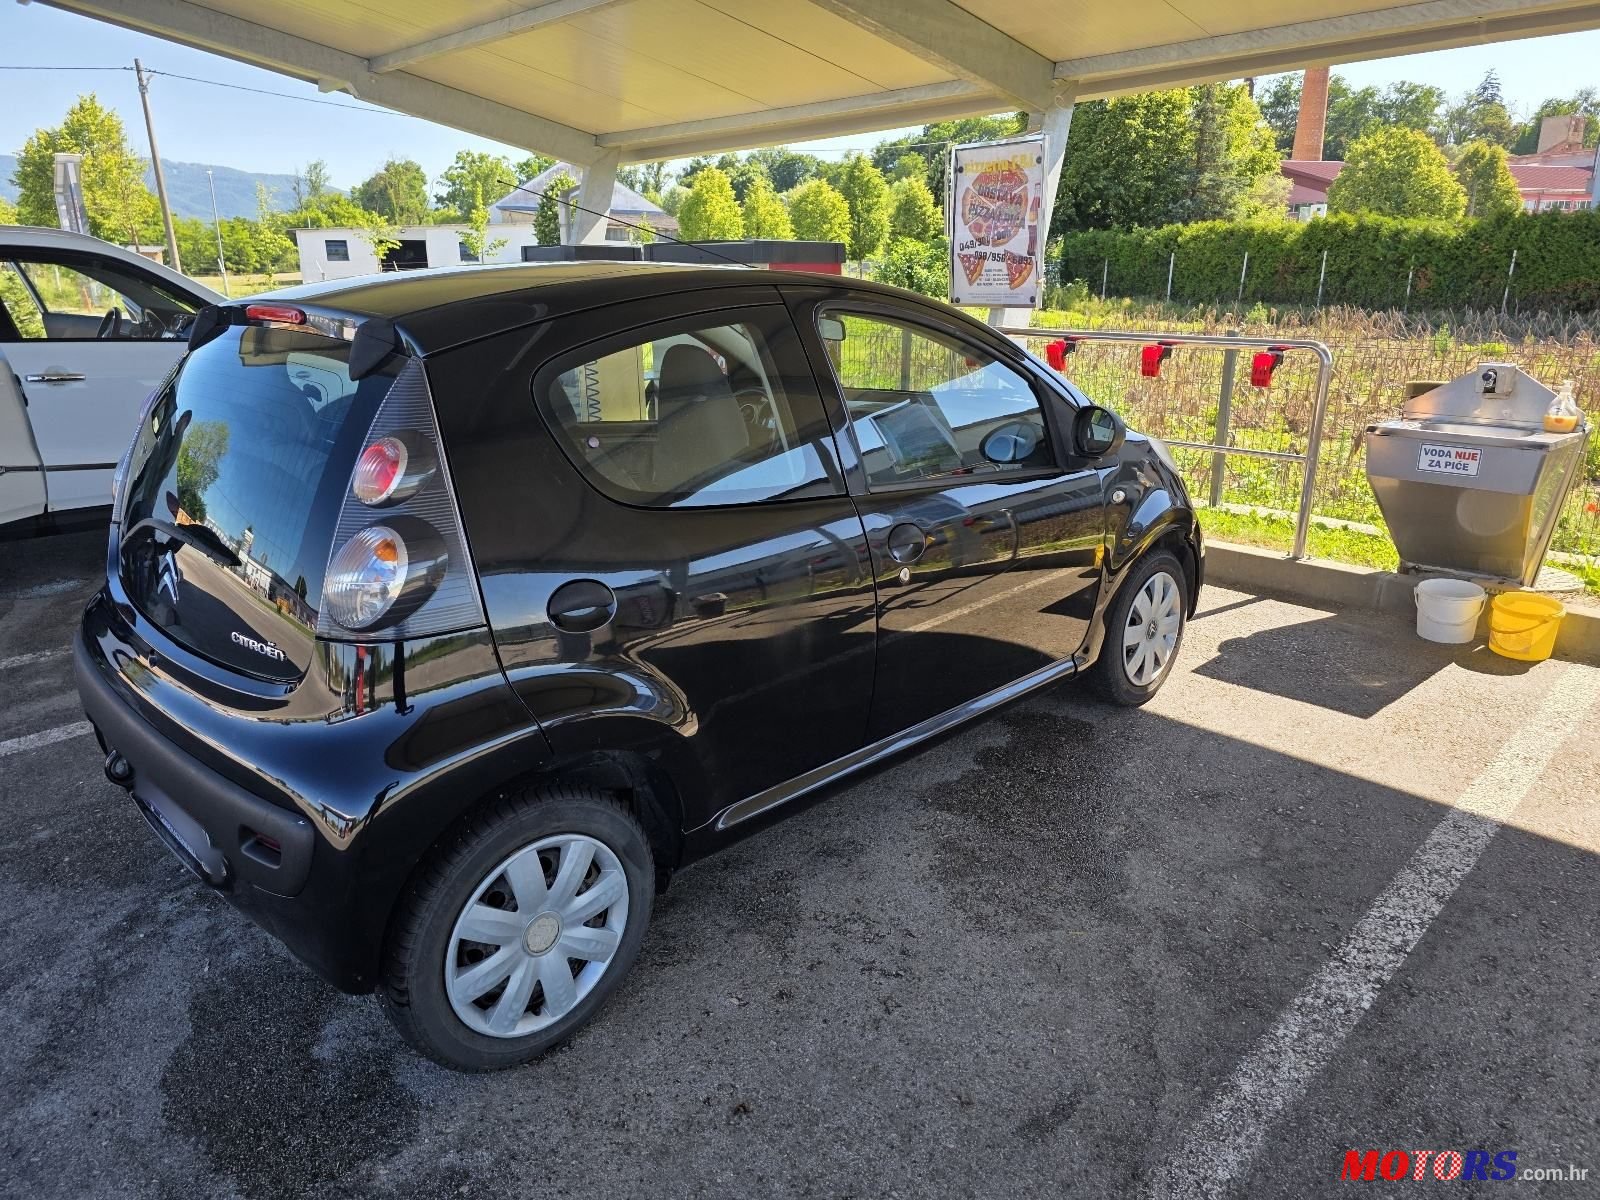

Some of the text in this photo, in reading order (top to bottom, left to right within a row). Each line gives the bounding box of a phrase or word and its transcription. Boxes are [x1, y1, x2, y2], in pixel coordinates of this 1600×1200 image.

[1424, 447, 1479, 461] VODA NIJE
[1428, 459, 1441, 469] ZA
